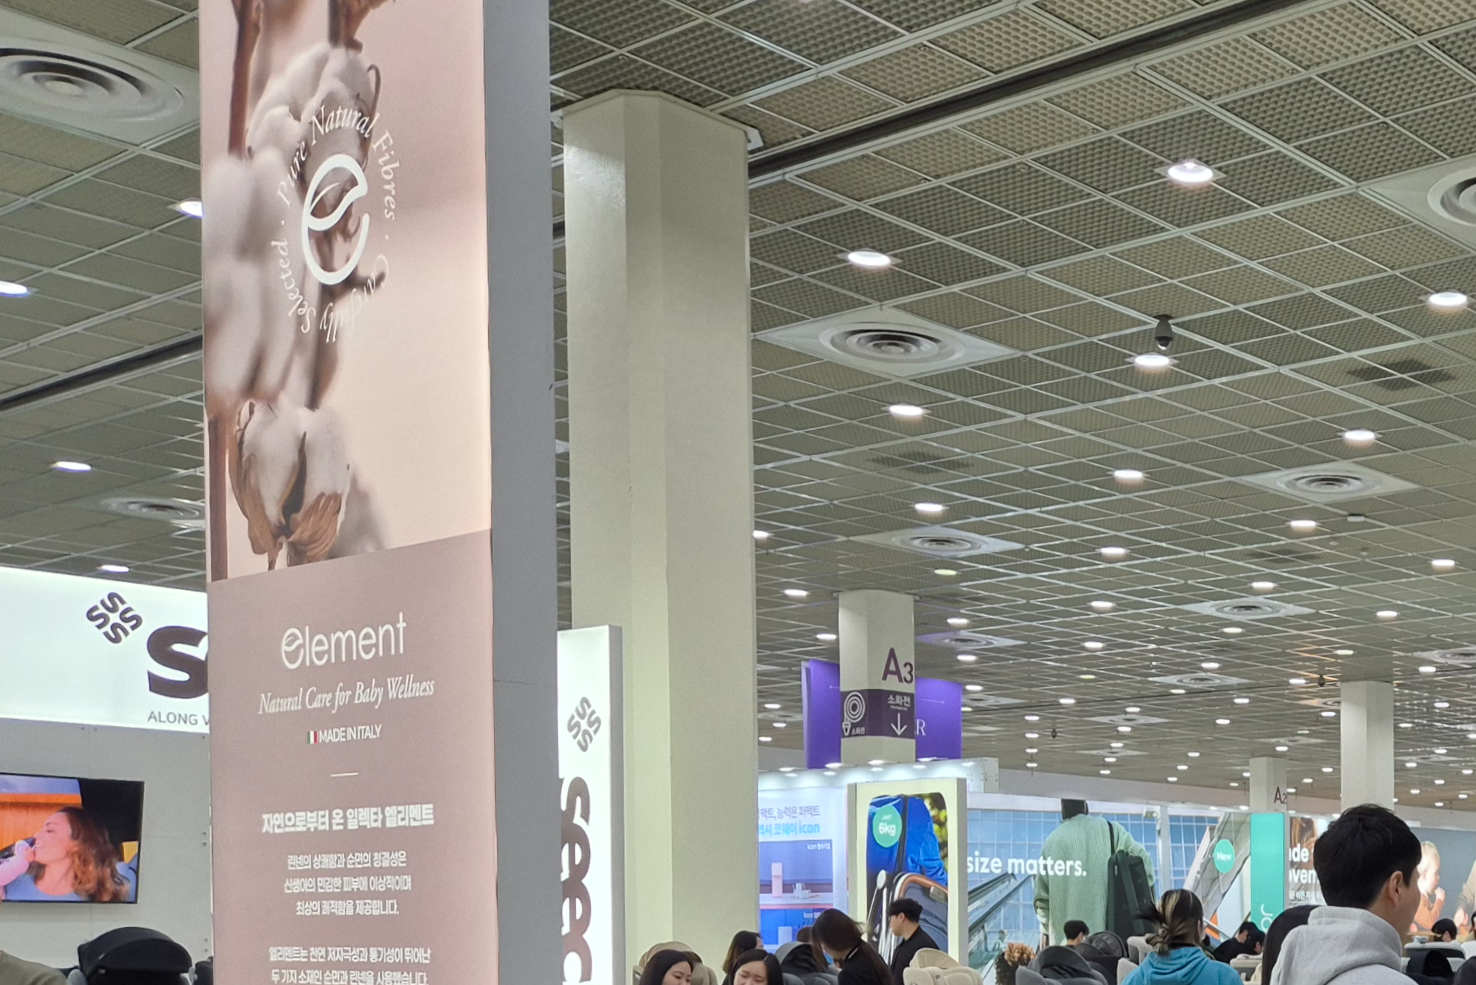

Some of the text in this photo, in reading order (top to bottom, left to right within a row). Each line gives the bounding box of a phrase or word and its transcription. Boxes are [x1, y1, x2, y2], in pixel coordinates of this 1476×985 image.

[308, 104, 380, 147] Natural
[372, 130, 401, 222] Fibres
[281, 611, 407, 670] element
[881, 647, 914, 684] A3
[258, 673, 435, 715] Natural Care for Baby Wellness
[147, 710, 199, 726] ALONG
[319, 724, 383, 744] MADE IN ITALY
[262, 809, 329, 833] 자연으로부터
[332, 809, 344, 830] 온
[385, 804, 435, 828] 엘리멘트
[798, 820, 820, 834] icon
[878, 822, 897, 837] 6kg
[346, 852, 371, 868] 순면의
[966, 850, 1087, 877] size matters.
[1216, 851, 1232, 861] New
[356, 899, 399, 916] 제공합니다.
[271, 969, 280, 984] 두
[281, 969, 297, 984] 가지
